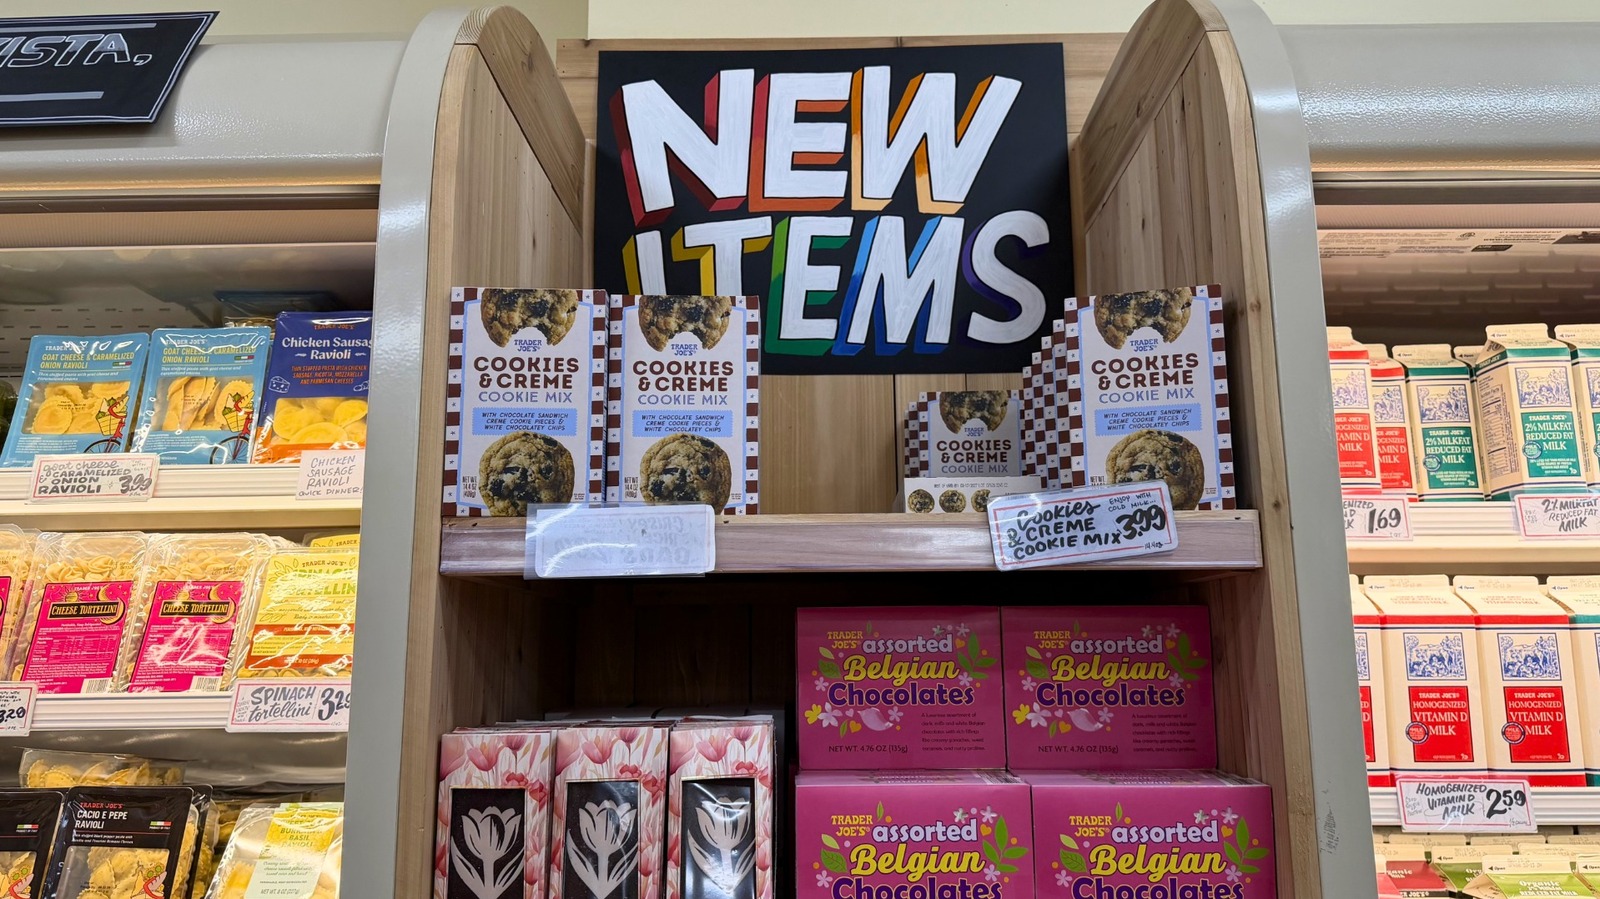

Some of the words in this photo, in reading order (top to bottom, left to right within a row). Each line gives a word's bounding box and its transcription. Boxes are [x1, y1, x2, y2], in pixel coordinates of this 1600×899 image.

[610, 66, 1023, 226] NEW
[622, 210, 1050, 356] ITEMS
[282, 337, 330, 347] Chicken
[1130, 338, 1159, 346] TRADER
[61, 353, 84, 361] CHEESE
[93, 352, 135, 360] CARAMELIZED
[214, 347, 256, 355] CARAMELIZED
[310, 349, 351, 360] Ravioli
[63, 361, 88, 369] RAVIOLI
[473, 356, 579, 373] COOKIES
[632, 360, 734, 376] COOKIES
[1091, 353, 1199, 375] COOKIES
[478, 391, 538, 403] COOKIE
[545, 392, 573, 403] MIX
[637, 394, 695, 405] COOKIE
[702, 394, 728, 405] MIX
[1099, 389, 1159, 404] COOKIE
[1166, 387, 1195, 400] MIX
[1160, 408, 1192, 416] SANDWICH
[1128, 422, 1169, 430] CHOCOLATEY
[1525, 422, 1537, 431] 2%
[1537, 422, 1572, 431] MILKFAT
[1437, 437, 1470, 445] MILKFAT
[1526, 432, 1562, 440] REDUCED
[1563, 431, 1574, 439] FAT
[936, 439, 1012, 451] COOKIES
[1340, 443, 1363, 451] MILK
[1427, 446, 1460, 454] REDUCED
[1462, 445, 1472, 453] FAT
[1543, 441, 1567, 450] MILK
[311, 455, 356, 468] CHICKEN
[43, 461, 74, 477] goat
[76, 460, 120, 469] cheese
[53, 469, 131, 478] CARAMELIZED
[307, 465, 356, 477] SAUSAGE
[941, 465, 984, 474] COOKIE
[988, 464, 1008, 473] MIX
[38, 484, 102, 495] RAVIOLI
[119, 473, 153, 494] 3.99
[51, 477, 99, 485] ONION
[307, 476, 350, 490] RAVIOLI
[326, 486, 363, 495] DINNER!
[1017, 500, 1101, 531] Cookies
[1109, 494, 1131, 505] ENJOY
[1135, 492, 1152, 500] WITH
[1541, 499, 1558, 513] 2%
[1560, 498, 1598, 511] MILKFAT
[1549, 509, 1583, 521] REDUCED
[1584, 508, 1598, 517] FAT
[1026, 517, 1096, 541] CREME
[1108, 503, 1126, 512] COLD
[1368, 508, 1401, 534] 1.69
[1559, 517, 1587, 532] MILK
[1013, 535, 1078, 560] COOKIE
[1083, 533, 1121, 546] MIX
[1115, 504, 1166, 540] 3.99
[52, 605, 79, 615] CHEESE
[79, 604, 118, 615] TORTELLINI
[163, 604, 189, 613] CHEESE
[191, 604, 229, 613] TORTELLINI
[827, 631, 863, 640] TRADER
[1033, 630, 1071, 639] TRADER
[832, 640, 859, 649] JOE'S
[862, 634, 953, 653] assorted
[1039, 640, 1066, 649] JOE'S
[1070, 635, 1163, 653] assorted
[843, 655, 960, 686] Belgian
[1051, 655, 1171, 687] Belgian
[250, 686, 317, 705] SPINACH
[828, 682, 975, 706] Chocolates
[1036, 682, 1185, 707] Chocolates
[248, 701, 313, 722] tortellini
[1414, 712, 1458, 721] VITAMIN
[1460, 712, 1468, 721] D
[1510, 712, 1554, 721] VITAMIN
[1556, 712, 1563, 721] D
[1429, 725, 1456, 735] MILK
[1525, 725, 1552, 735] MILK
[888, 744, 908, 754] (135g)
[1416, 783, 1487, 796] HOMOGENIZED
[1486, 788, 1526, 819] 2.59
[1428, 794, 1467, 810] VITAMIN
[1468, 794, 1475, 802] D
[77, 810, 100, 819] CACIO
[102, 811, 107, 819] E
[109, 811, 128, 819] PEPE
[1442, 803, 1475, 820] MILK
[75, 820, 104, 829] RAVIOLI
[831, 815, 873, 825] TRADER
[1069, 815, 1112, 826] TRADER
[836, 826, 867, 837] JOE'S
[872, 818, 978, 842] assorted
[1075, 827, 1106, 837] JOE'S
[1111, 820, 1219, 843] assorted
[850, 844, 986, 882] Belgian
[1089, 844, 1227, 882] Belgian
[832, 876, 1002, 899] Chocolates
[1072, 876, 1244, 899] Chocolates
